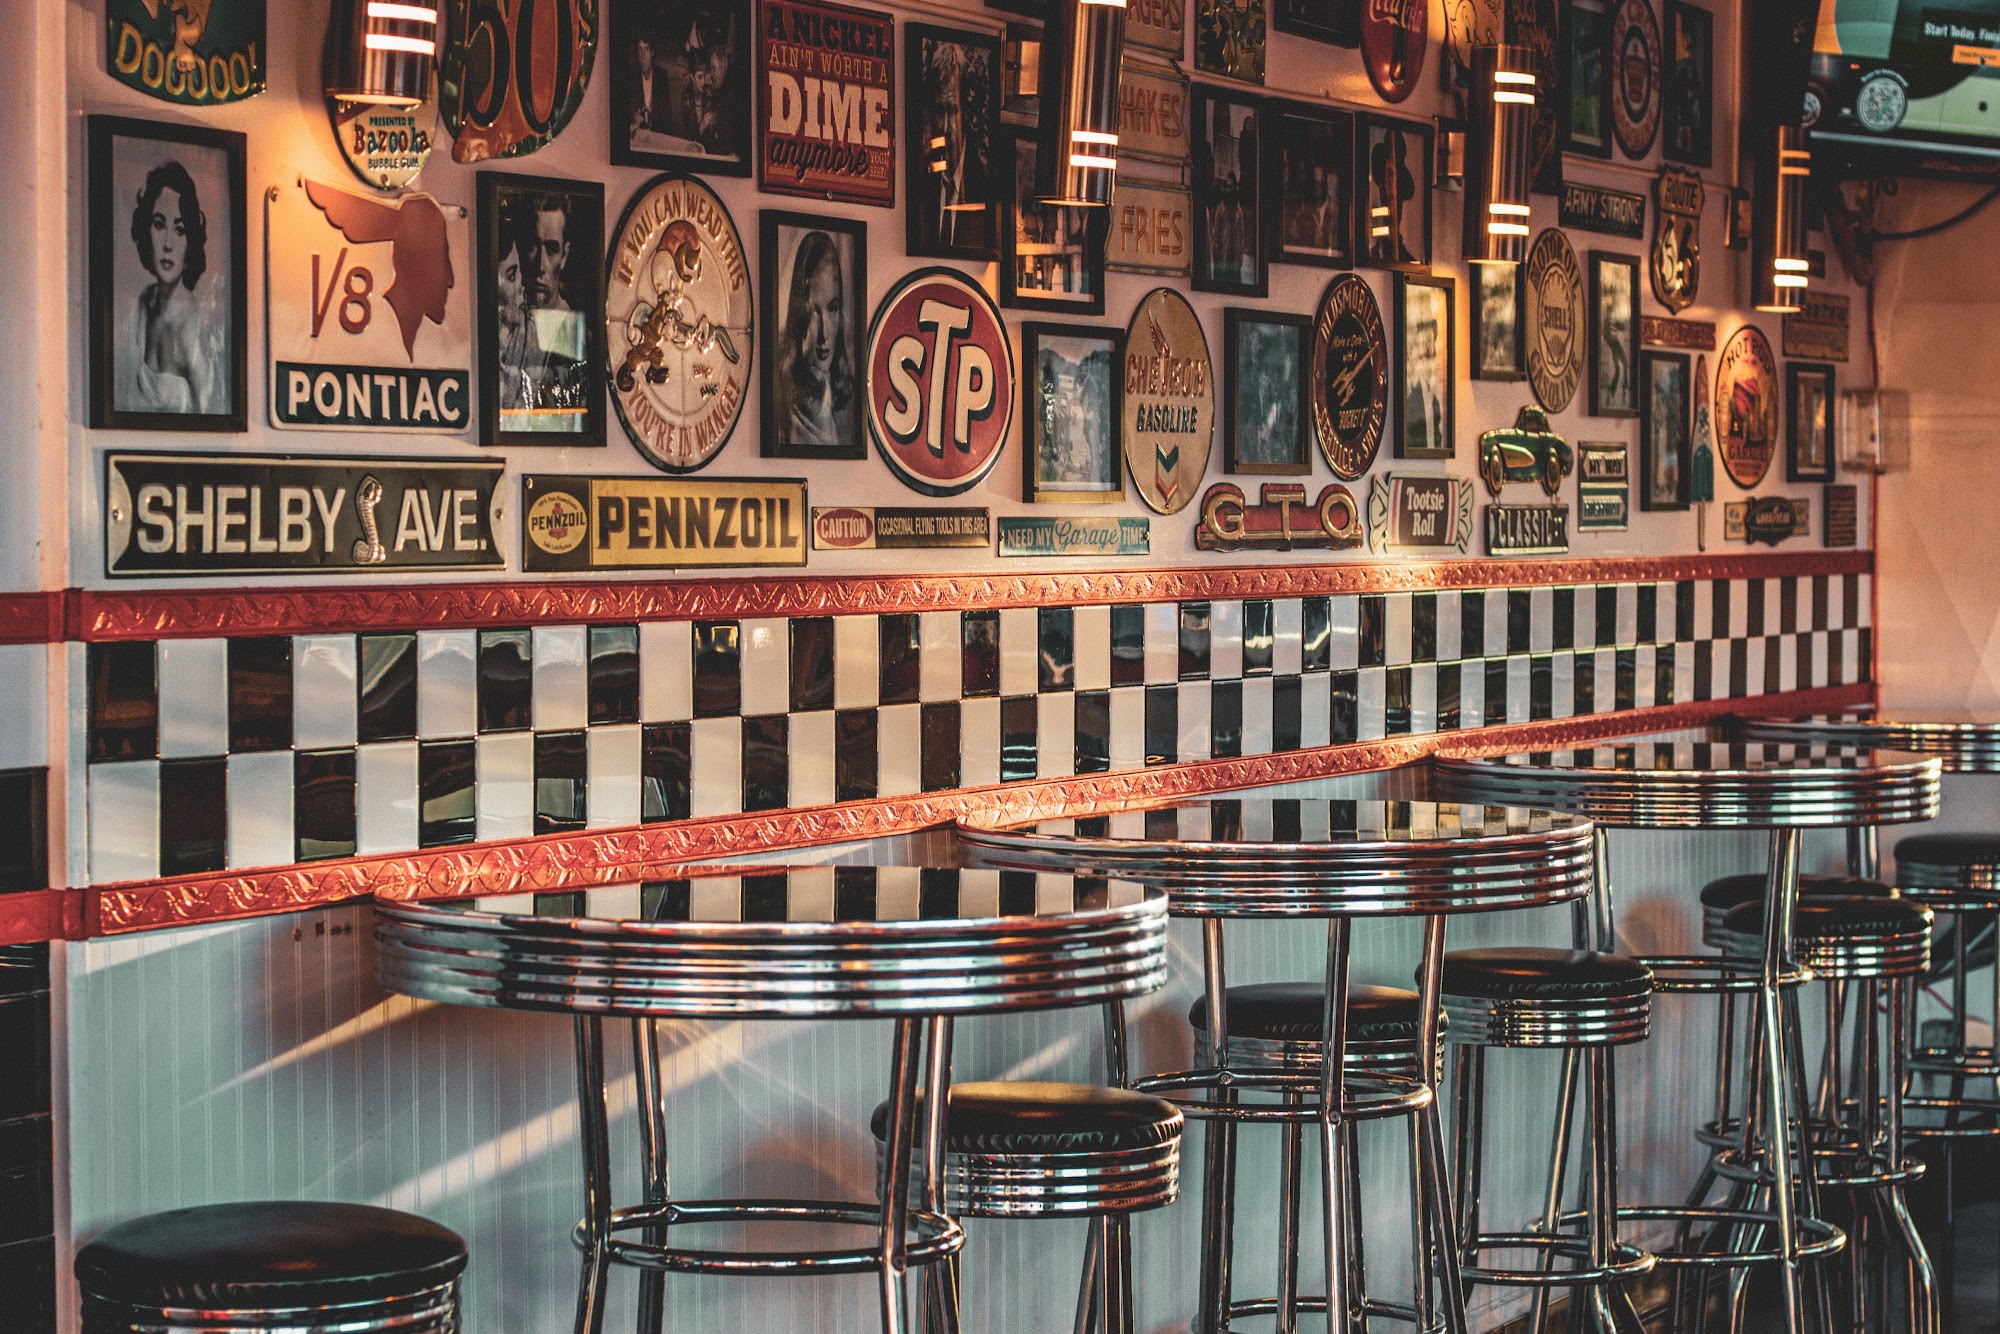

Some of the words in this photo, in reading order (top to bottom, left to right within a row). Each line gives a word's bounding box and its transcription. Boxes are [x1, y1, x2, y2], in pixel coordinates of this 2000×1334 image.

[767, 6, 787, 41] A
[792, 10, 889, 58] NICKEL
[1923, 21, 1948, 37] Start
[769, 43, 814, 70] AIN'T
[820, 52, 872, 81] WORTH
[879, 63, 888, 83] A
[369, 117, 406, 126] PRESENTED
[768, 70, 889, 149] DIME
[1120, 85, 1181, 138] HAKES
[354, 124, 430, 155] Bazooka
[368, 157, 398, 170] BUBBLE
[401, 157, 420, 169] GUM
[769, 138, 869, 182] anymore
[1563, 188, 1598, 216] ARMY
[1600, 194, 1642, 225] STRONG
[1665, 177, 1697, 210] ROUTE
[626, 209, 653, 256] YOU
[654, 191, 682, 226] CAN
[687, 191, 723, 240] WEAD
[721, 230, 745, 292] THIS
[1120, 206, 1183, 255] FRIES
[311, 247, 373, 338] V8
[1320, 284, 1379, 341] OLDSMOBILE
[1543, 305, 1568, 331] SHELL
[1127, 352, 1207, 397] CHEVRON
[1727, 338, 1749, 371] HOT
[287, 370, 461, 422] PONTIAC
[884, 299, 996, 459] STP
[628, 379, 676, 454] YOU'RE
[679, 426, 693, 457] IN
[1137, 403, 1198, 433] GASOLINE
[1318, 406, 1353, 472] SERVICE
[1588, 457, 1601, 475] MY
[1604, 457, 1622, 475] WAY
[137, 483, 346, 554] SHELBY
[393, 488, 487, 553] AVE.
[1206, 491, 1357, 541] GTO
[1406, 486, 1445, 511] Tootsie
[531, 511, 586, 532] PENNZOIL
[598, 495, 801, 550] PENNZOIL
[820, 517, 868, 539] CAUTION
[877, 516, 914, 536] OCCASIONAL
[916, 516, 934, 536] FLYING
[935, 516, 953, 536] TOOLS
[954, 516, 960, 535] IN
[961, 516, 972, 535] THIS
[973, 516, 988, 535] AREA
[1007, 528, 1034, 548] NEED
[1036, 527, 1051, 547] MY
[1055, 520, 1119, 553] Garage
[1412, 511, 1436, 537] Roll
[1498, 509, 1552, 547] CLASSIC
